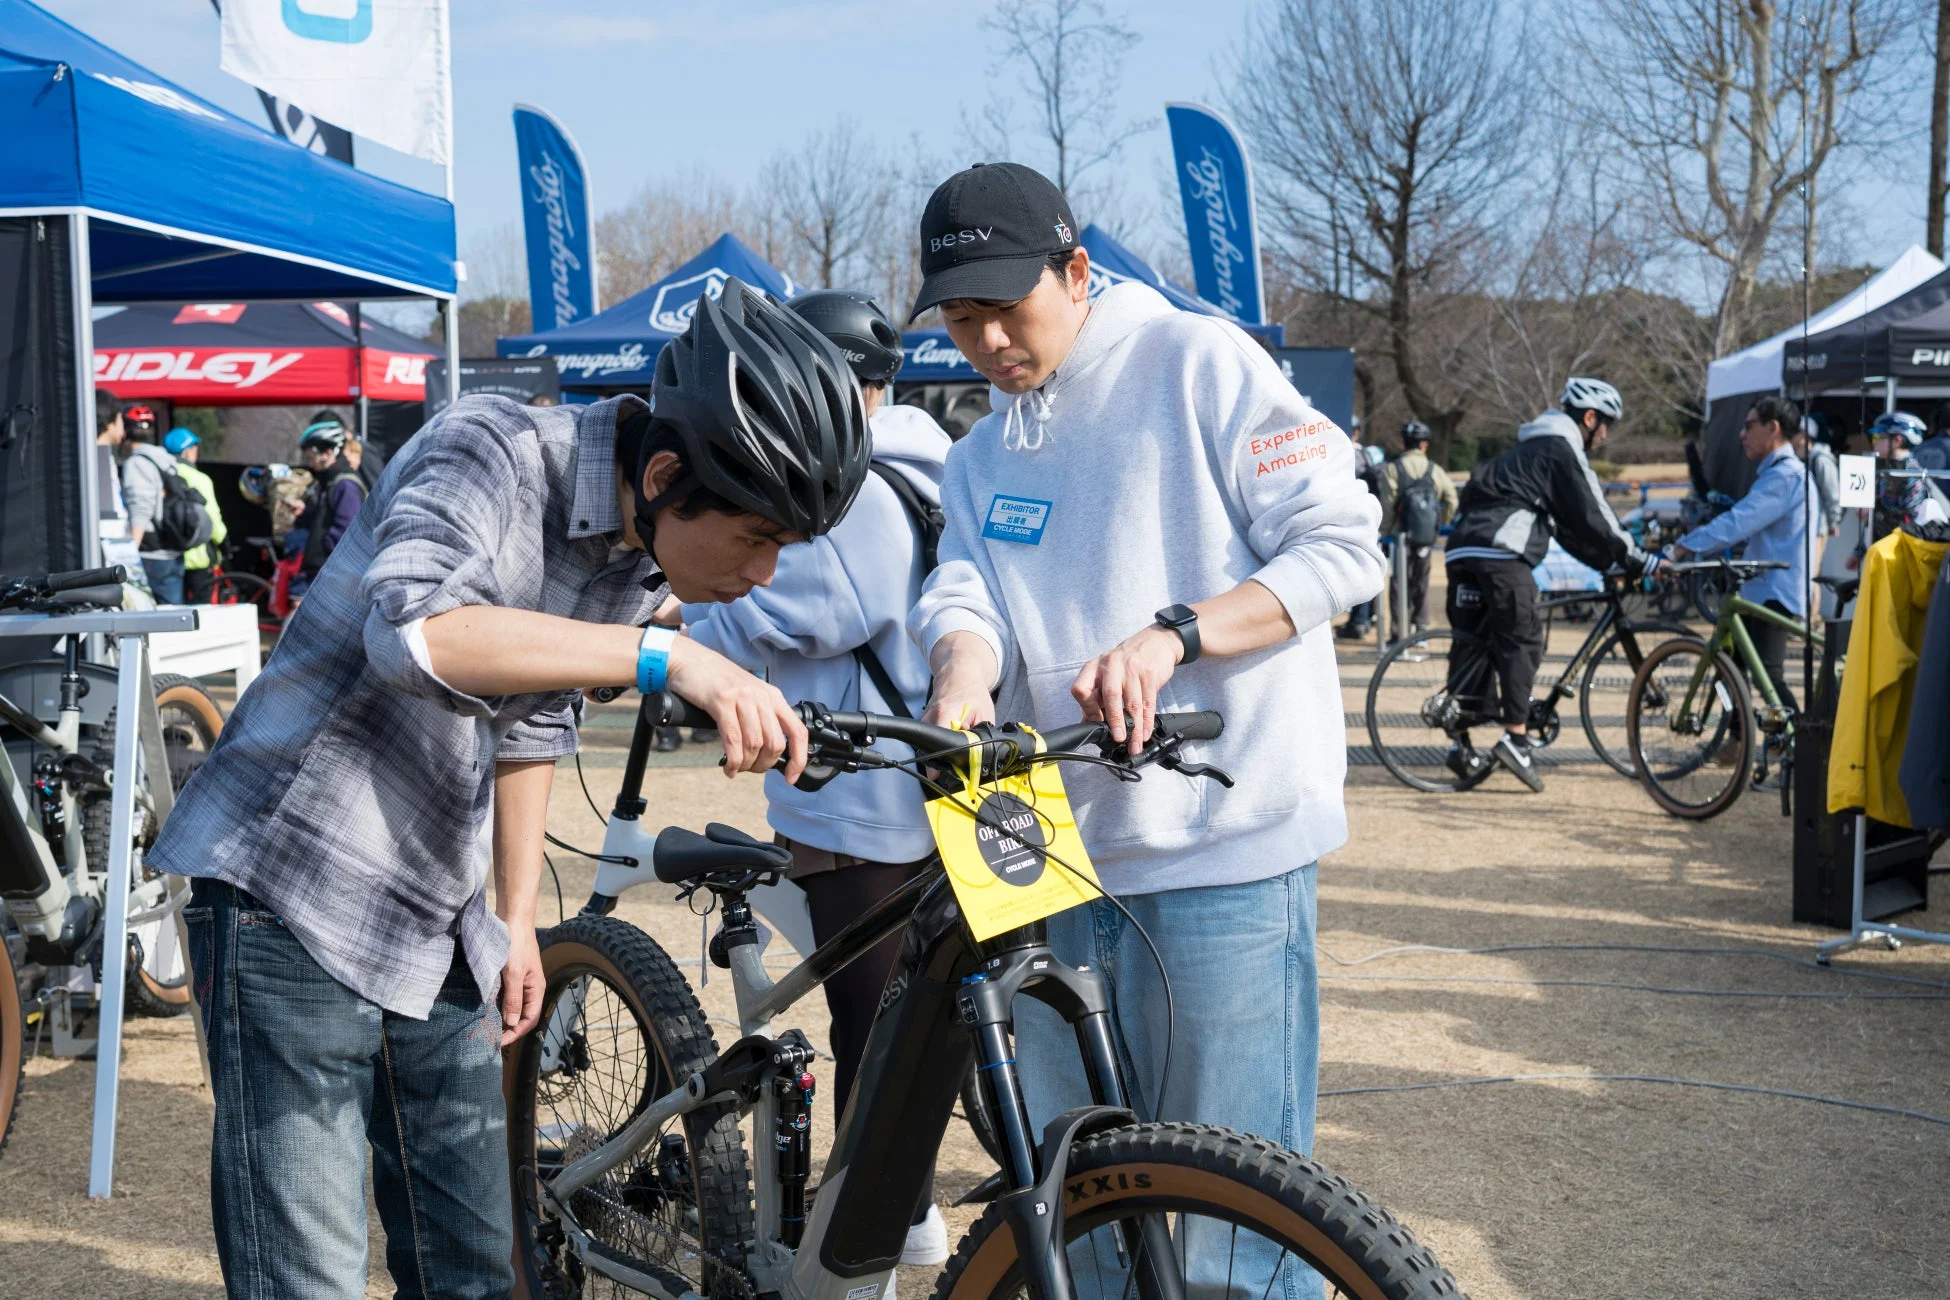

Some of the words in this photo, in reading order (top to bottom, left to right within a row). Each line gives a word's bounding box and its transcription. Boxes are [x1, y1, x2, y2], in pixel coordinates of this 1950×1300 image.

[1251, 420, 1333, 455] Experienc
[1256, 443, 1327, 477] Amazing
[1001, 502, 1040, 515] EXHIBITOR
[993, 524, 1014, 533] CYCLE
[1013, 527, 1033, 536] MODE
[1002, 813, 1034, 832] ROAD
[1067, 1173, 1152, 1203] XXIS
